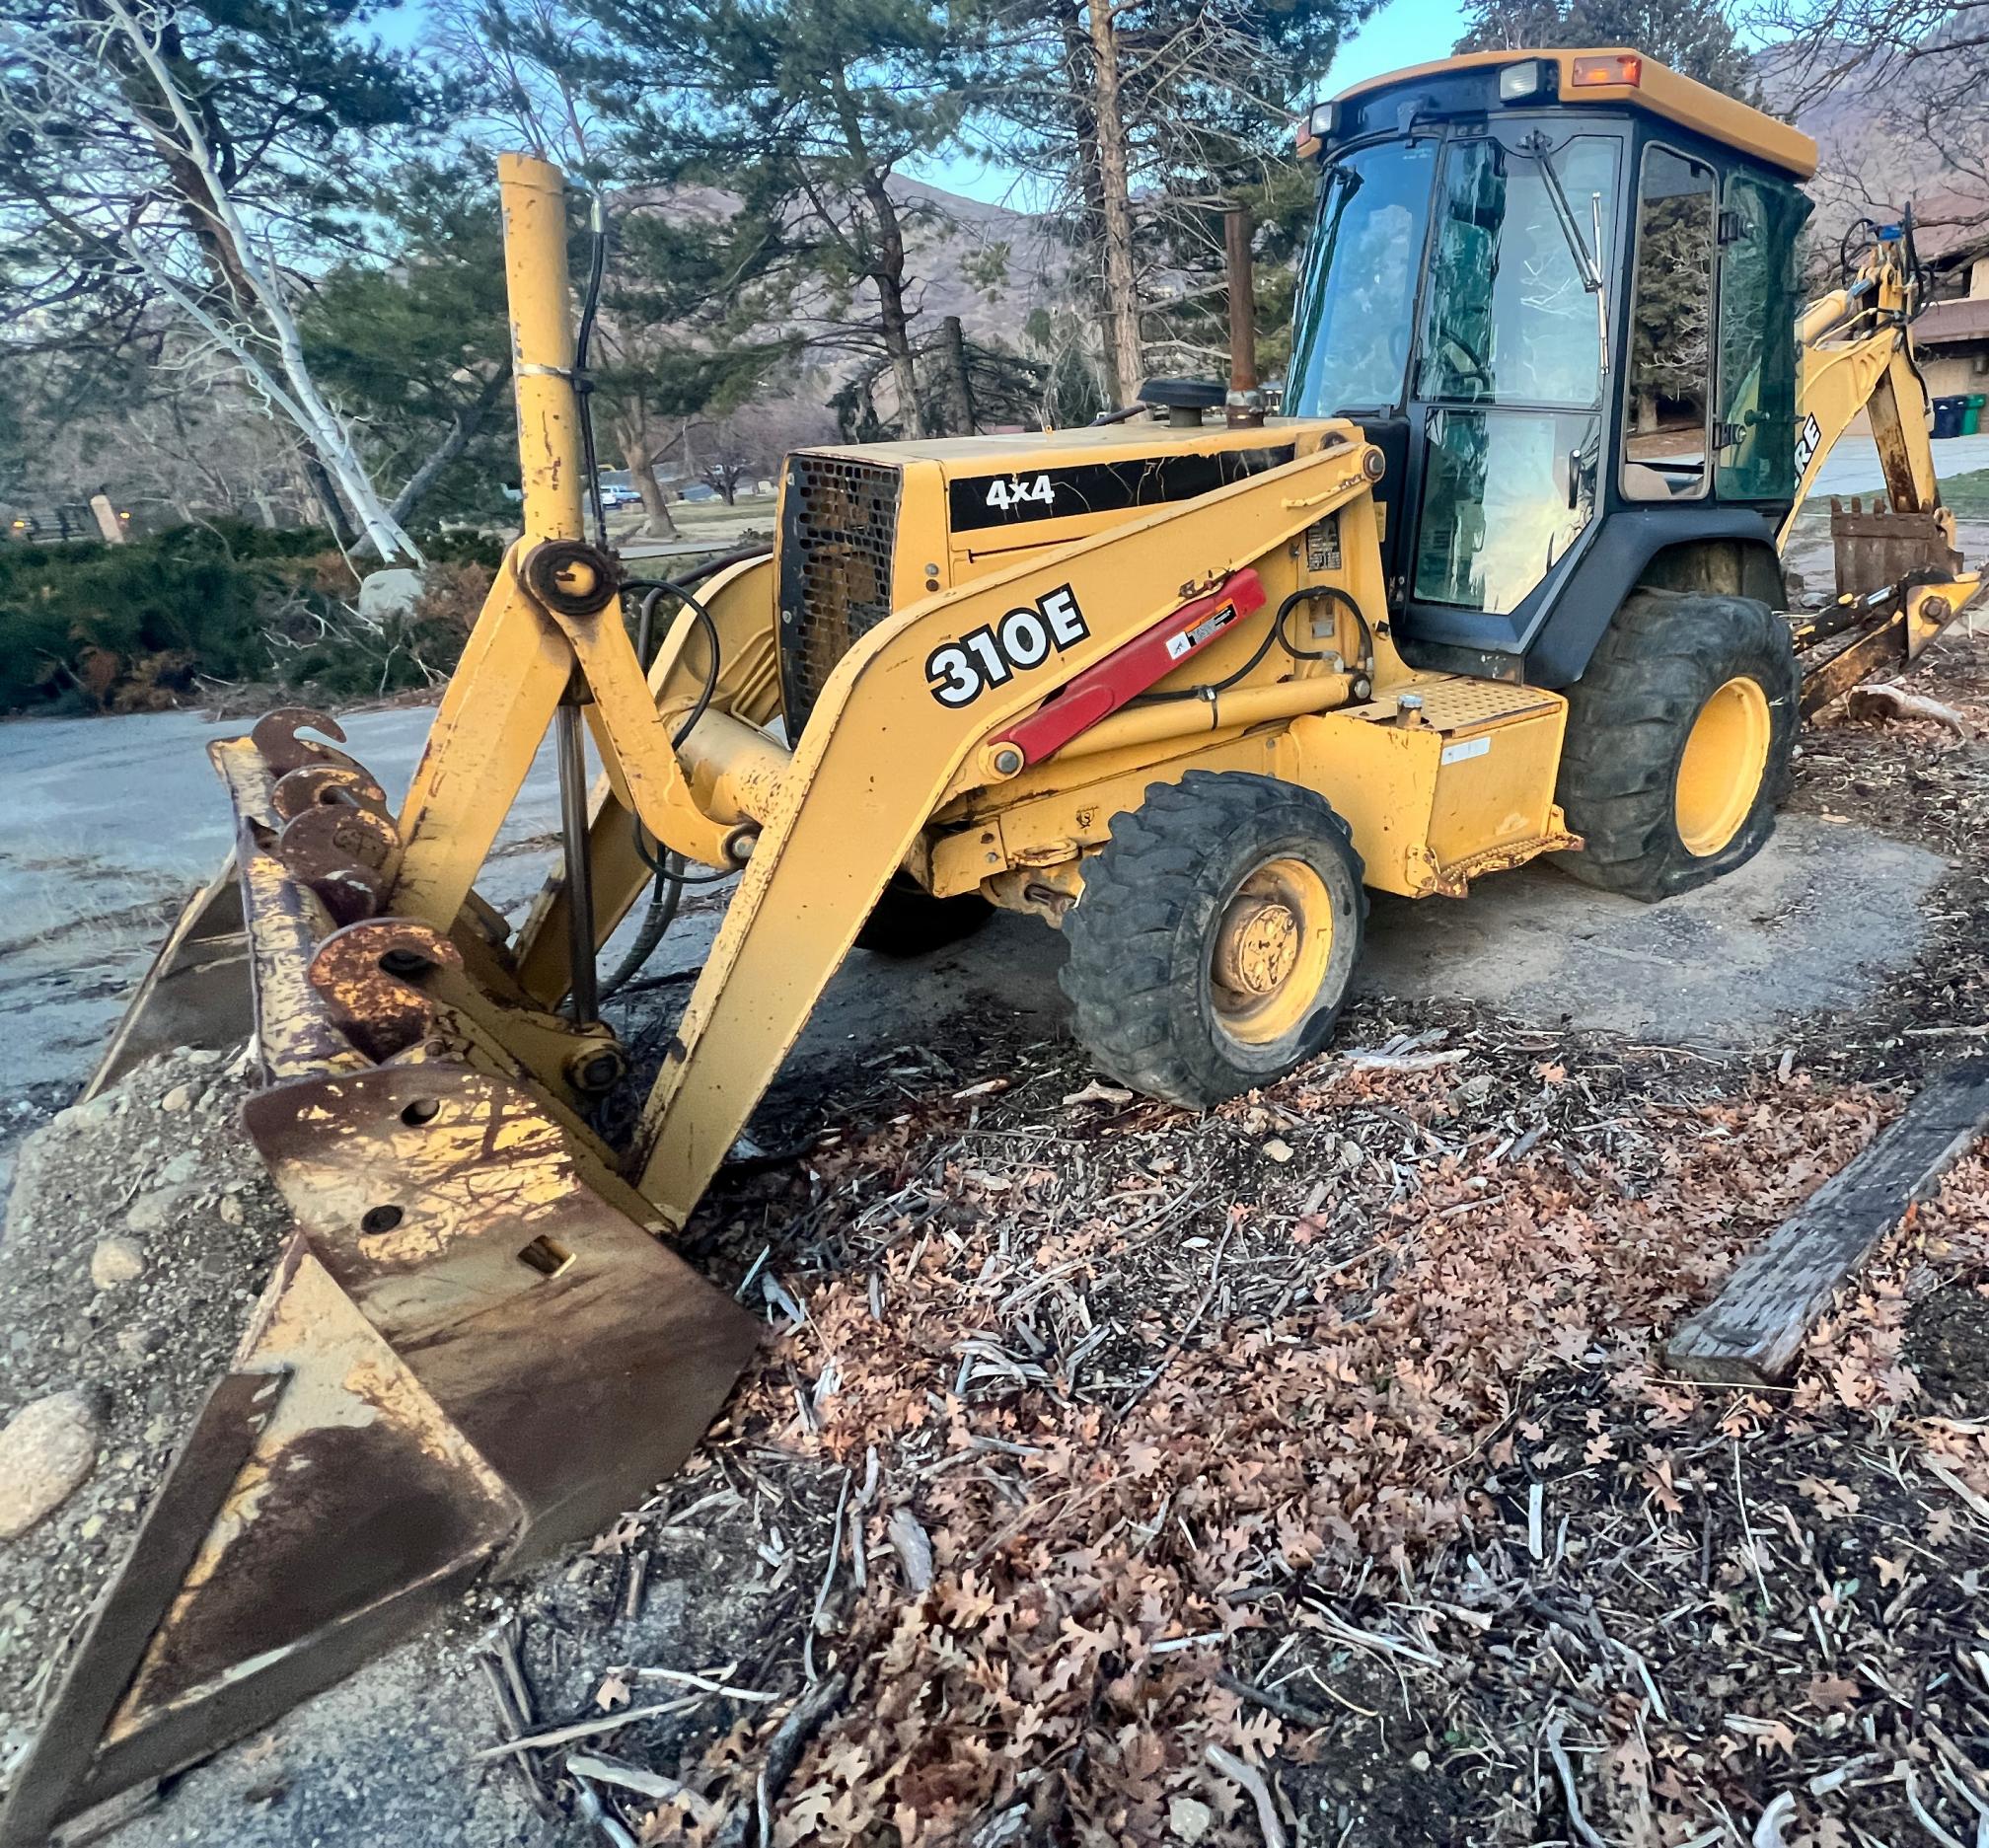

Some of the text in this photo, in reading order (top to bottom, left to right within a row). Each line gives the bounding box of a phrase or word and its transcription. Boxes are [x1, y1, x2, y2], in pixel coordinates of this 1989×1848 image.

[1794, 411, 1821, 490] RE
[986, 475, 1056, 510] 4x4
[925, 582, 1091, 708] 310E
